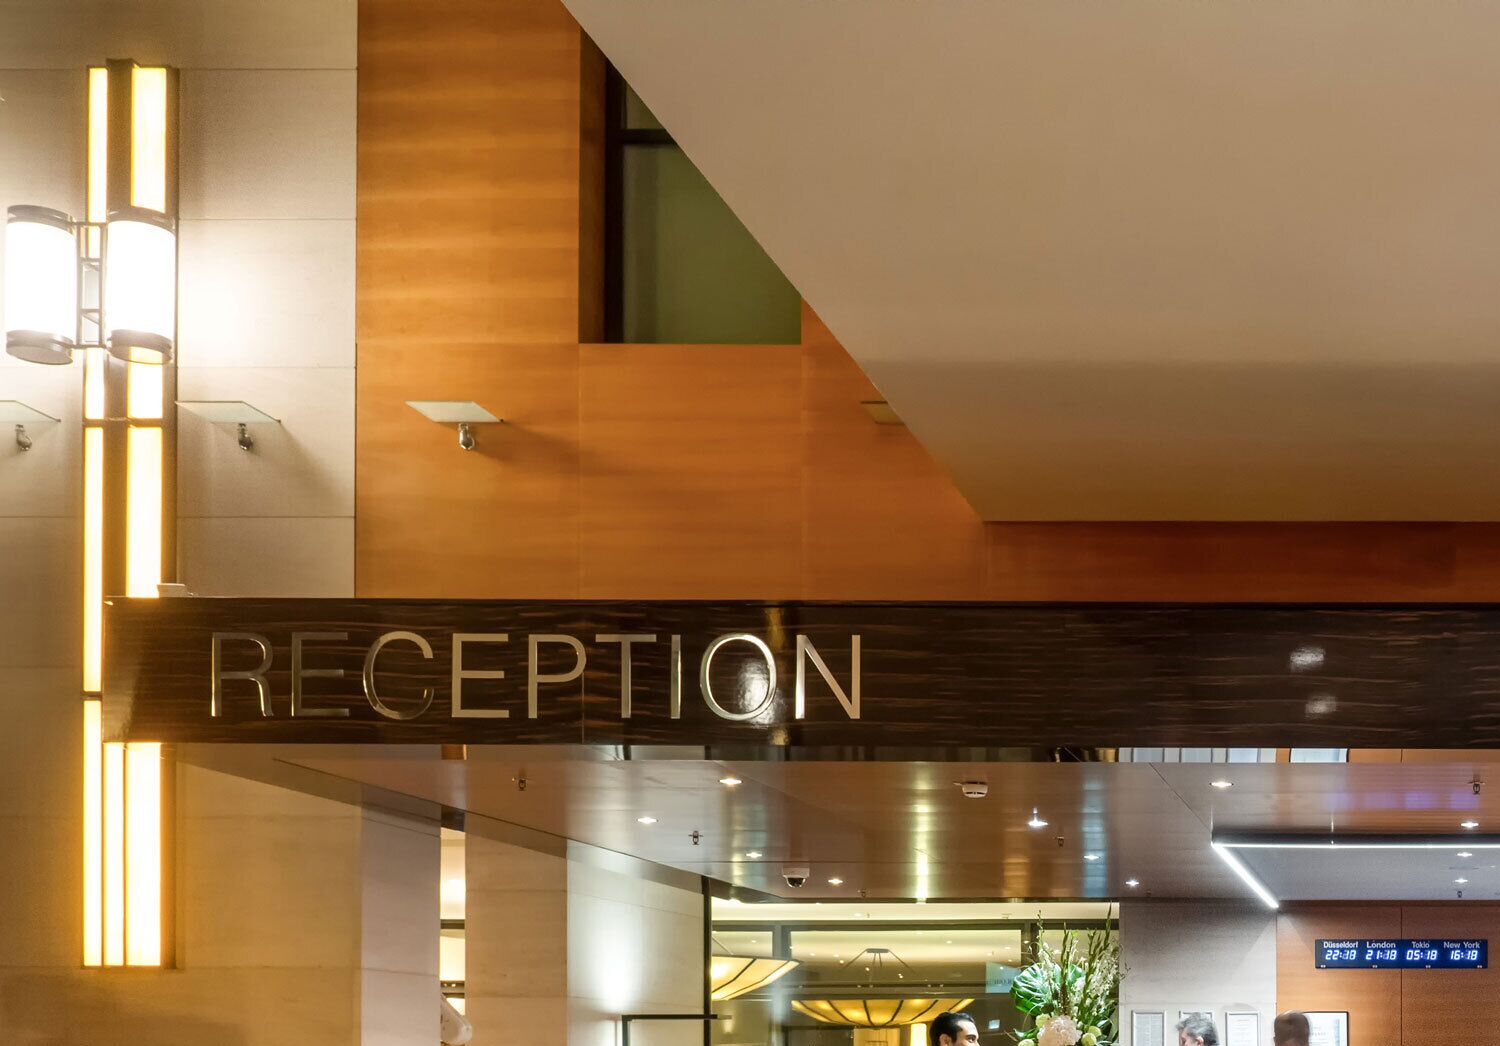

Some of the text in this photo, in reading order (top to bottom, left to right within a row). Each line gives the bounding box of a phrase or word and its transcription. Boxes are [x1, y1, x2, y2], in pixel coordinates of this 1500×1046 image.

[211, 631, 861, 720] RECEPTION
[1323, 941, 1480, 949] Düsseldorf London Tokio New York
[1325, 949, 1478, 960] 22:18 21:18 05:18 16:18
